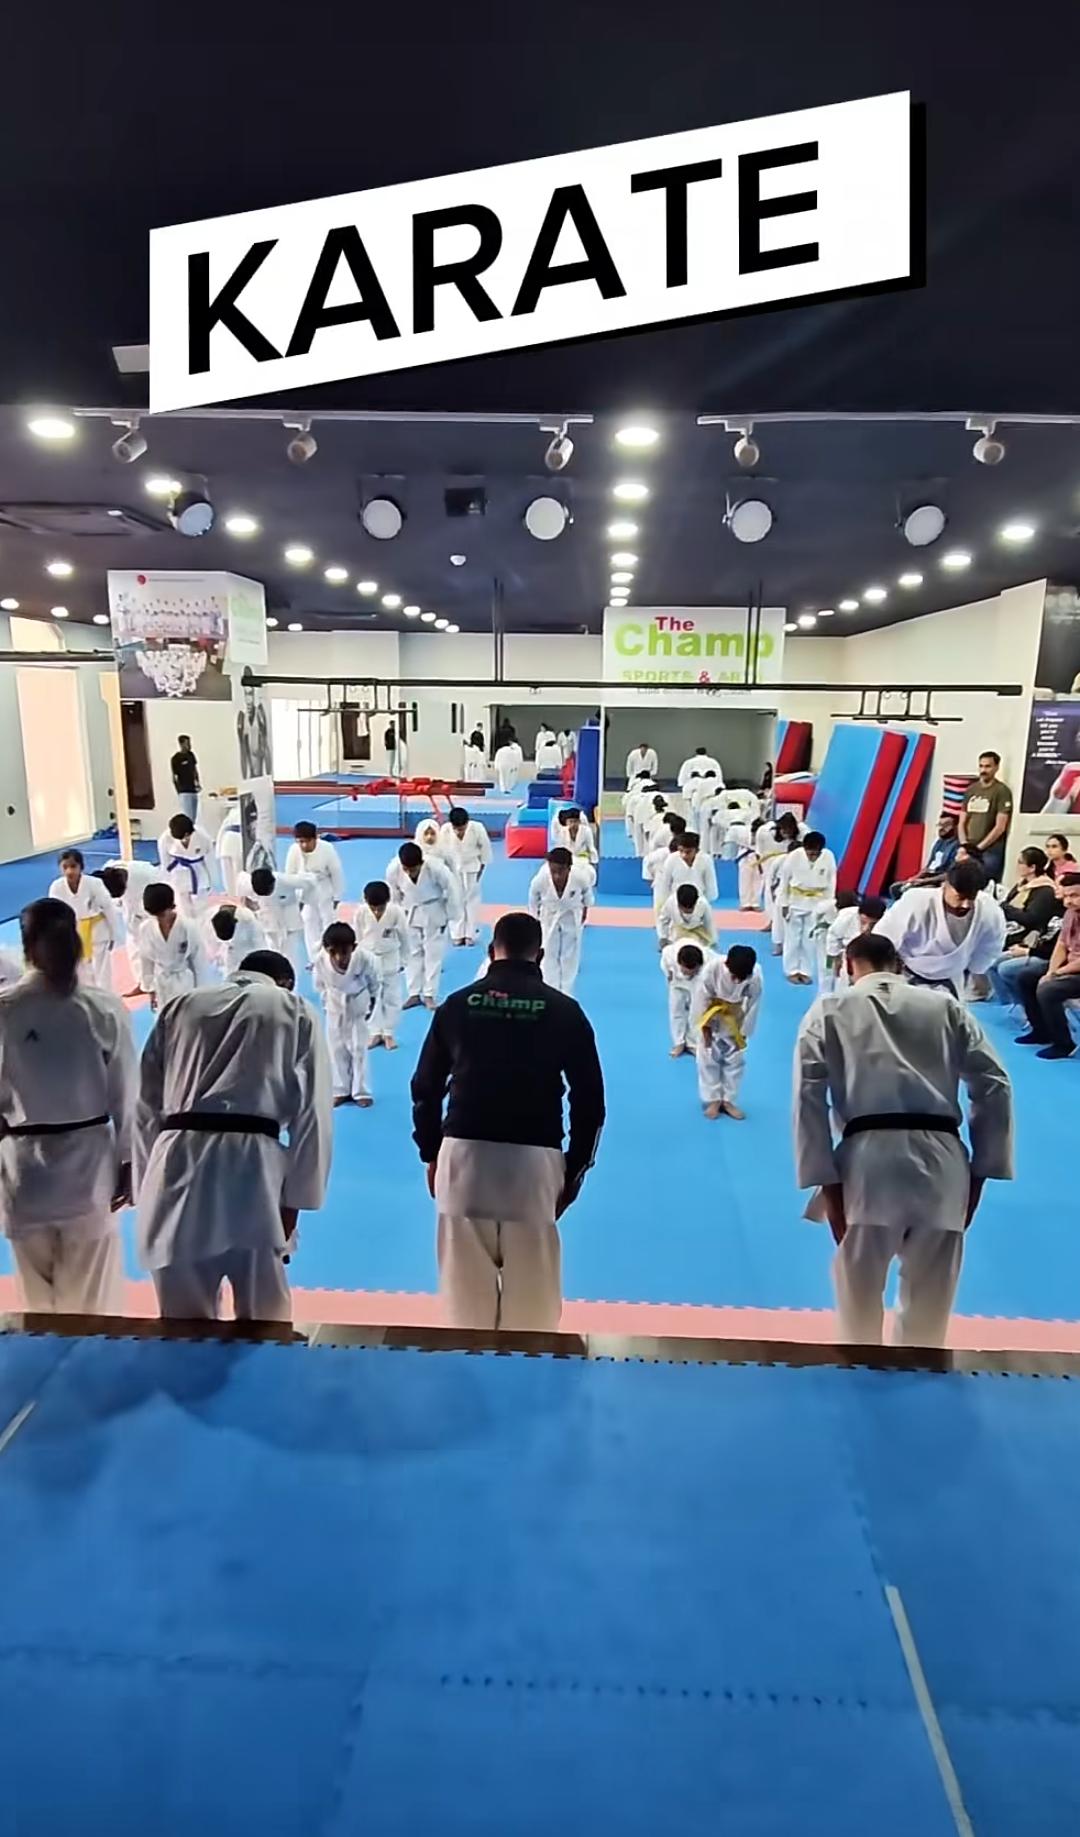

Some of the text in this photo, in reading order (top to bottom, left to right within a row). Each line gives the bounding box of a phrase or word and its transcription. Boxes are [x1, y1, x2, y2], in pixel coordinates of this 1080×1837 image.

[655, 616, 695, 632] The
[613, 622, 775, 665] Champ
[622, 669, 694, 683] SPORTS
[698, 670, 712, 685] &
[467, 993, 546, 1013] Champ
